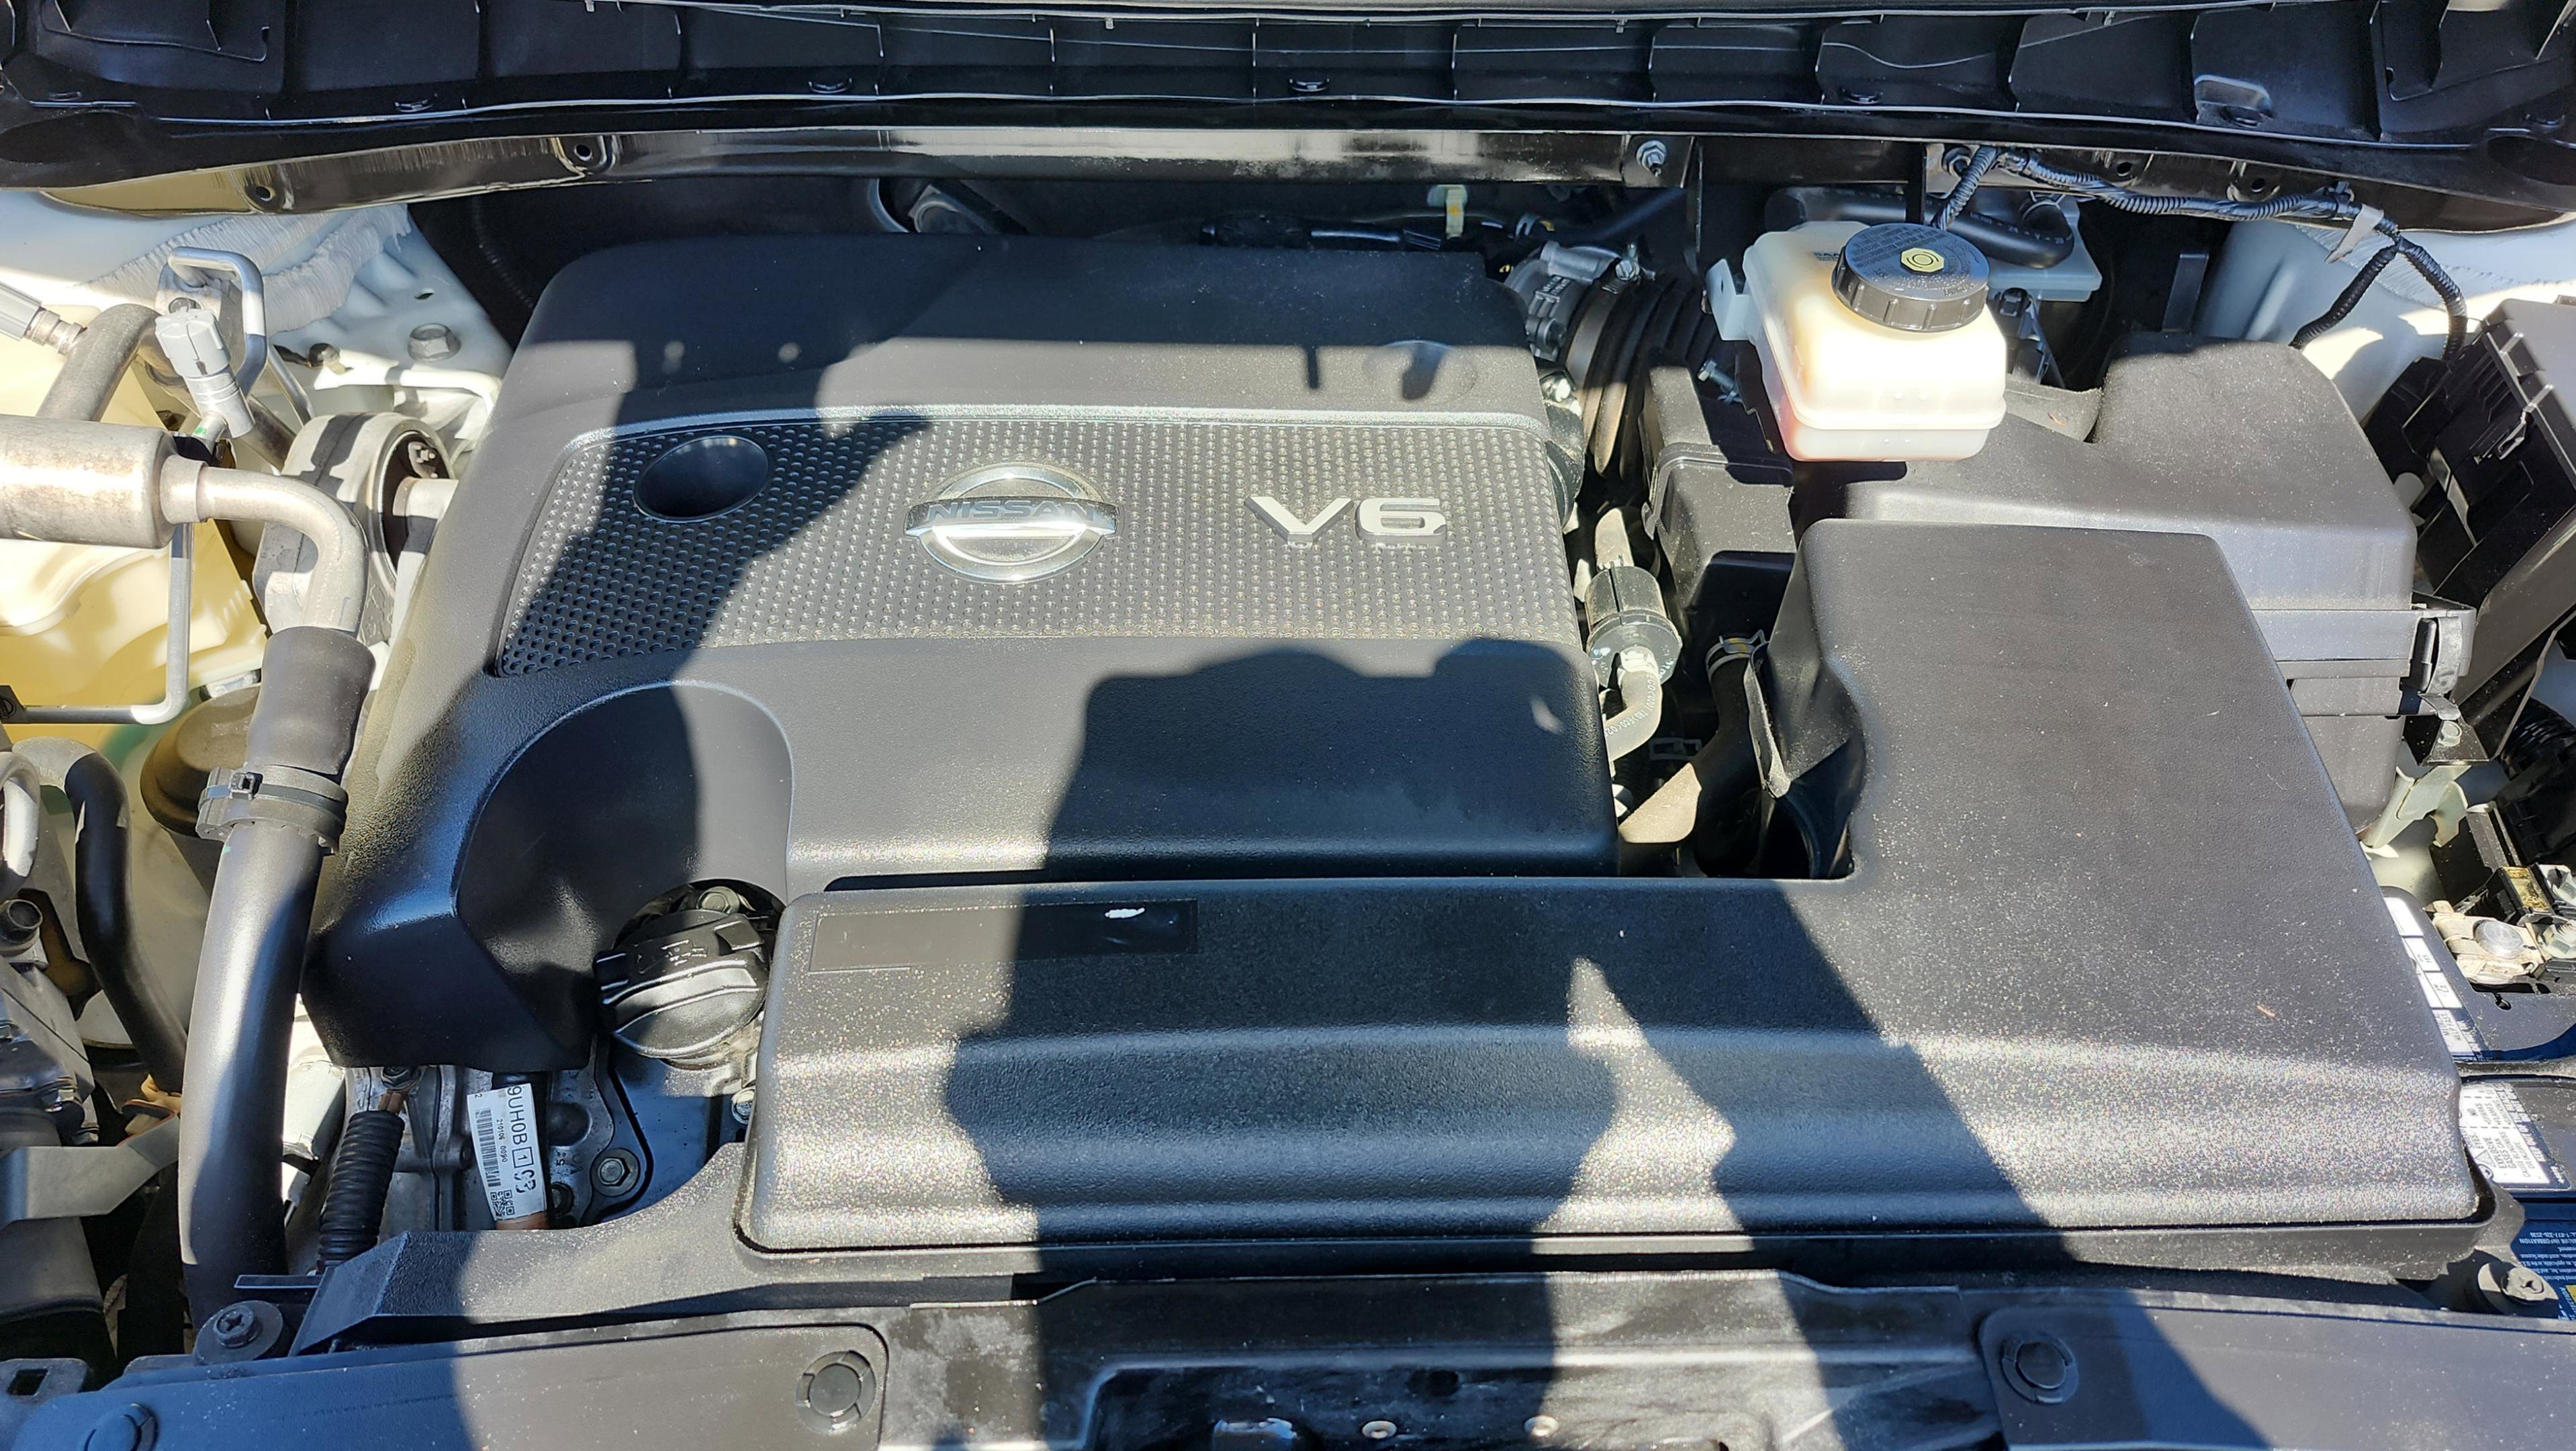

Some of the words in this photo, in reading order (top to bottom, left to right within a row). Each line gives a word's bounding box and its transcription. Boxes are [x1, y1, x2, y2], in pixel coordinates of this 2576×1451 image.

[927, 498, 1095, 522] NISSAN
[1244, 495, 1448, 546] V6
[507, 1086, 528, 1145] 9UH0B
[2467, 1108, 2476, 1116] NO
[2481, 1137, 2508, 1168] EXPLOSIVE
[2493, 1138, 2505, 1148] CAN
[2498, 1131, 2520, 1159] BLINDNESS
[2499, 1150, 2517, 1168] GASES
